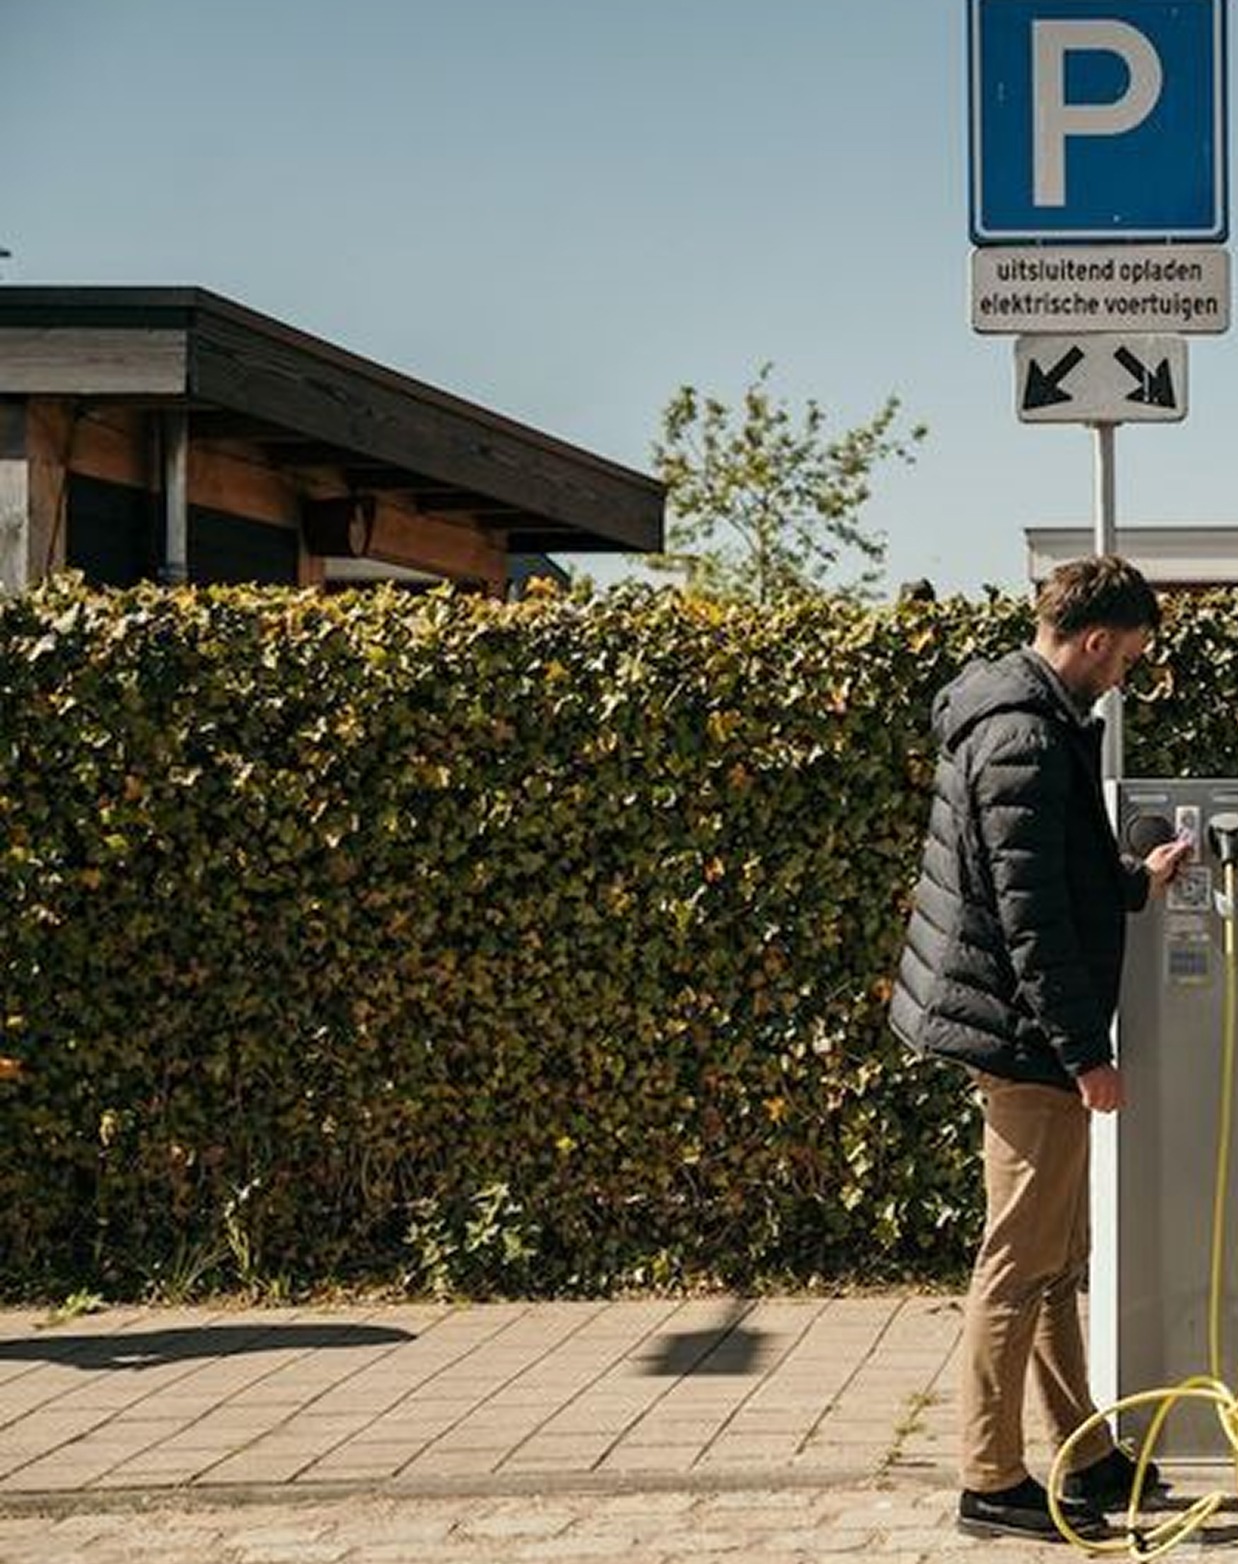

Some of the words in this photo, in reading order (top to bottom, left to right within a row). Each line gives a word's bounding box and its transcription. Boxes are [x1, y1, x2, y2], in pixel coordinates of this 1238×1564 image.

[1031, 18, 1164, 207] P
[997, 258, 1114, 282] uitsluitend
[1119, 258, 1202, 284] opladen
[980, 292, 1099, 315] elektrische
[1104, 295, 1218, 321] voertuigen
